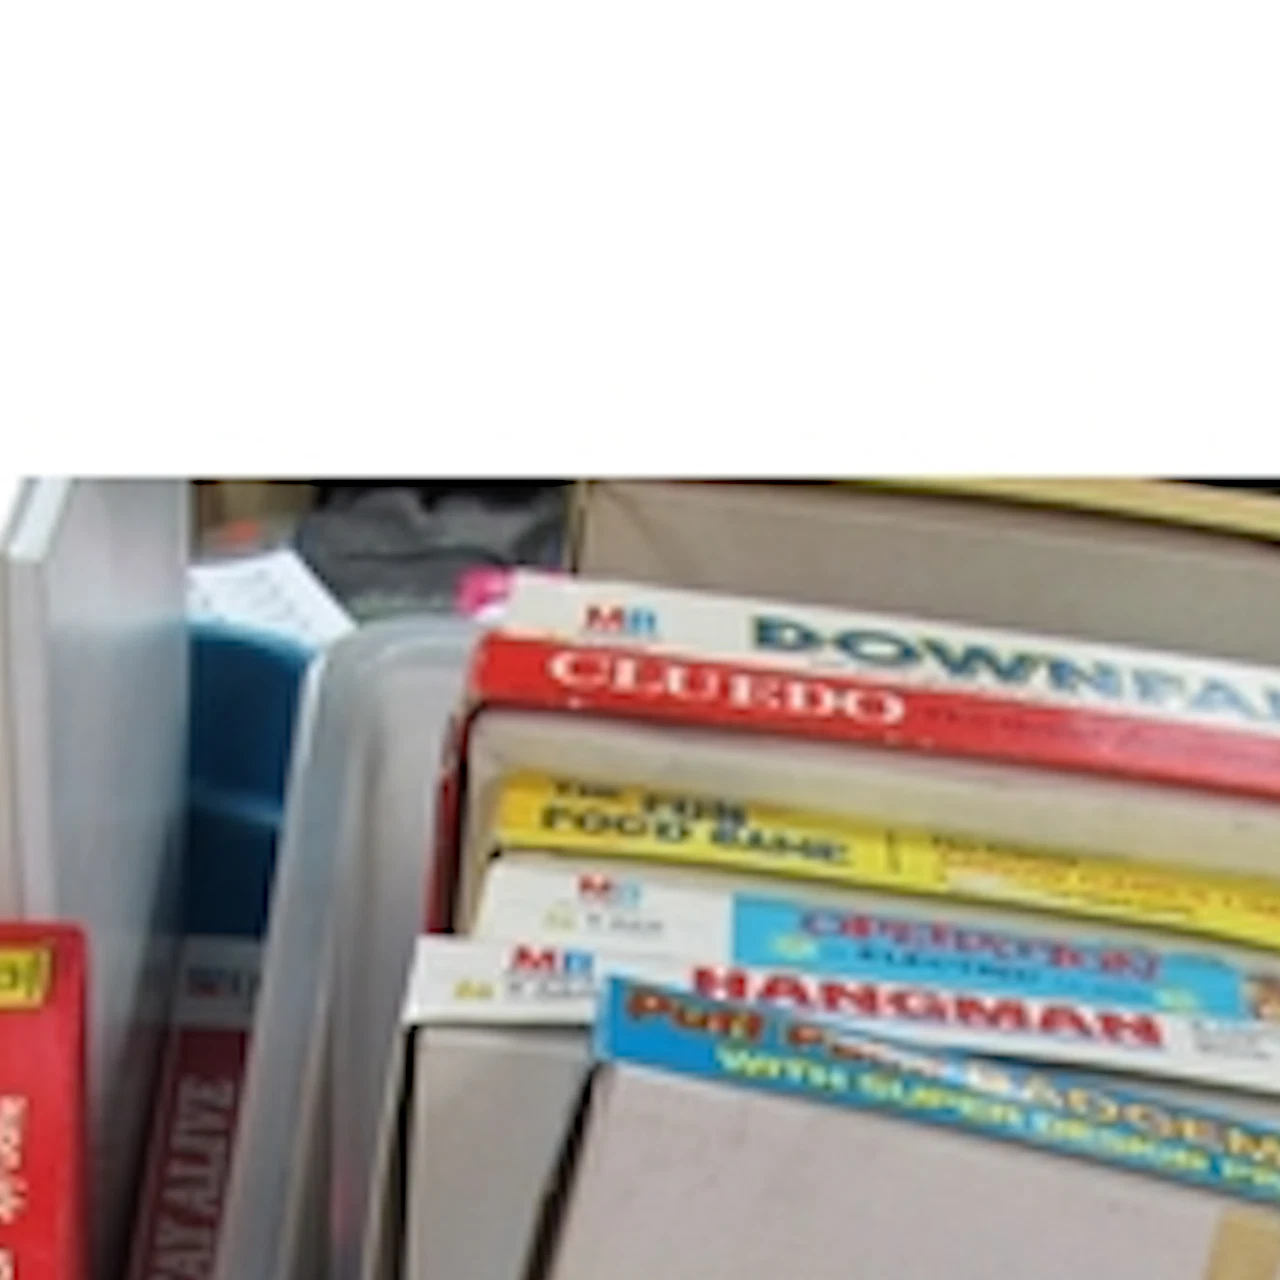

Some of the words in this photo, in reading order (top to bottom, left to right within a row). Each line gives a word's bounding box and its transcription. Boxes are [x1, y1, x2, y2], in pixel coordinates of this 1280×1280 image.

[549, 649, 906, 726] CLUEDO
[541, 804, 688, 841] FOOD
[692, 963, 1163, 1049] HANGMAN
[162, 1072, 236, 1218] ALIVE
